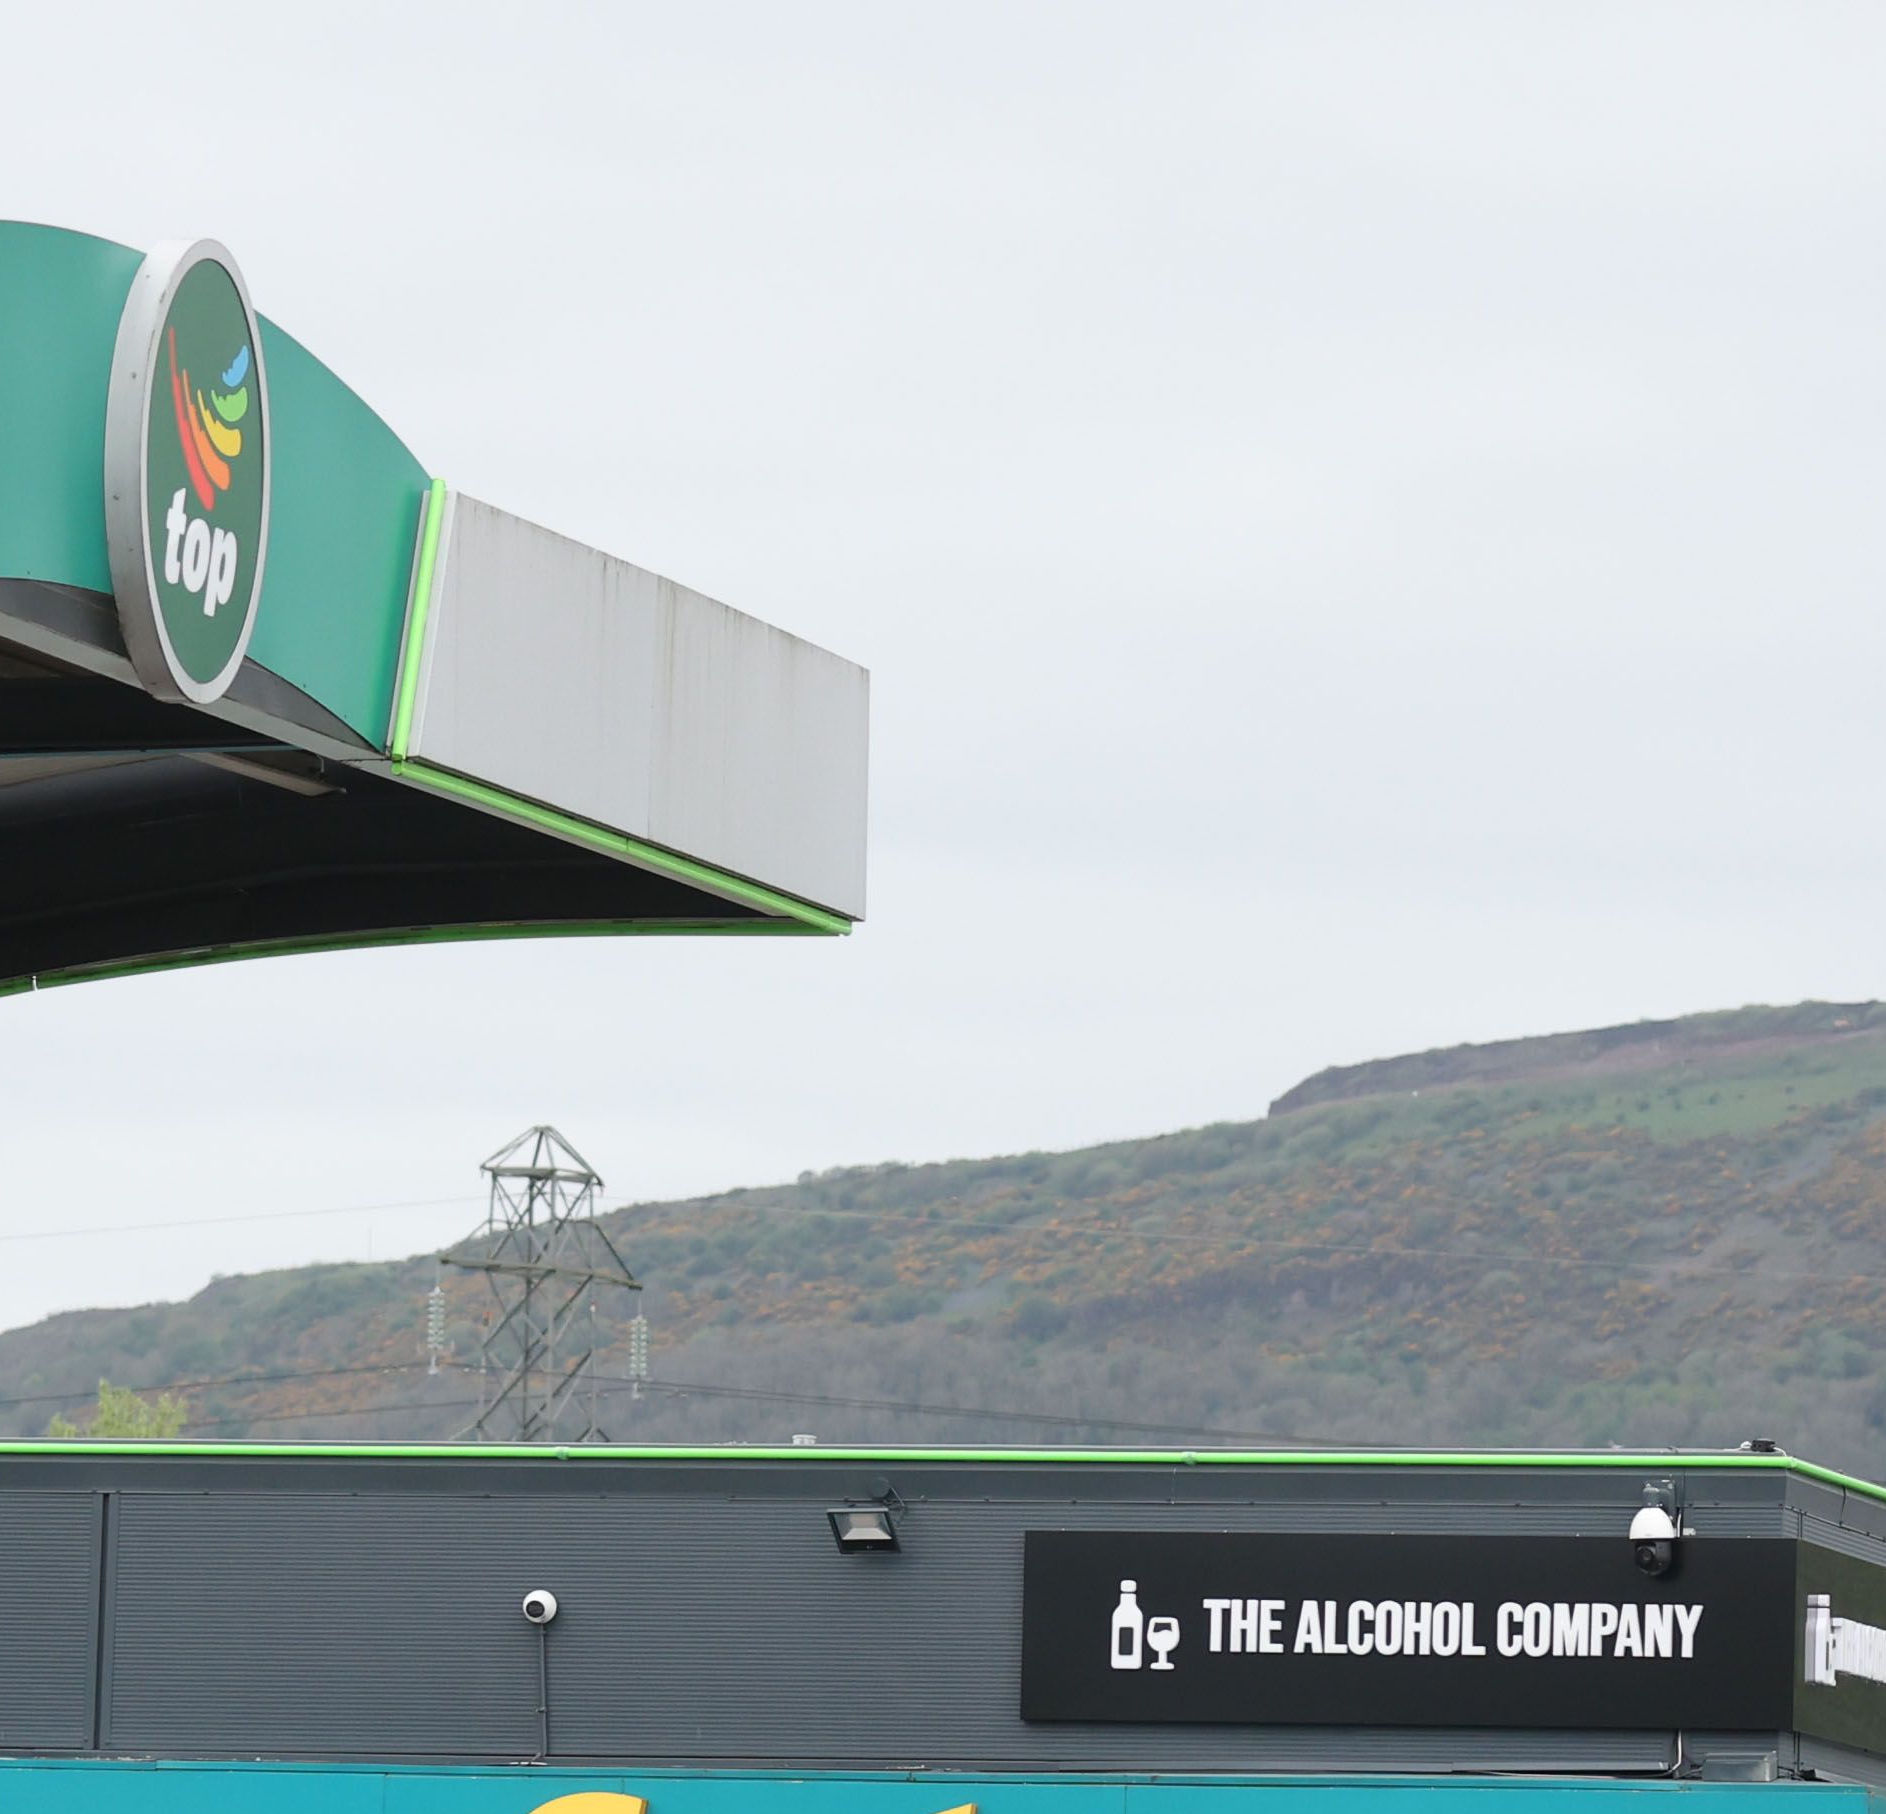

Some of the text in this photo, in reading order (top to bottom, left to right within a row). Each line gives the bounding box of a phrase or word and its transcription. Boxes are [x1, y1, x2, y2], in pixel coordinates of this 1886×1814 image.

[165, 488, 237, 616] top
[1202, 1598, 1703, 1660] THE ALCOHOL COMPANY
